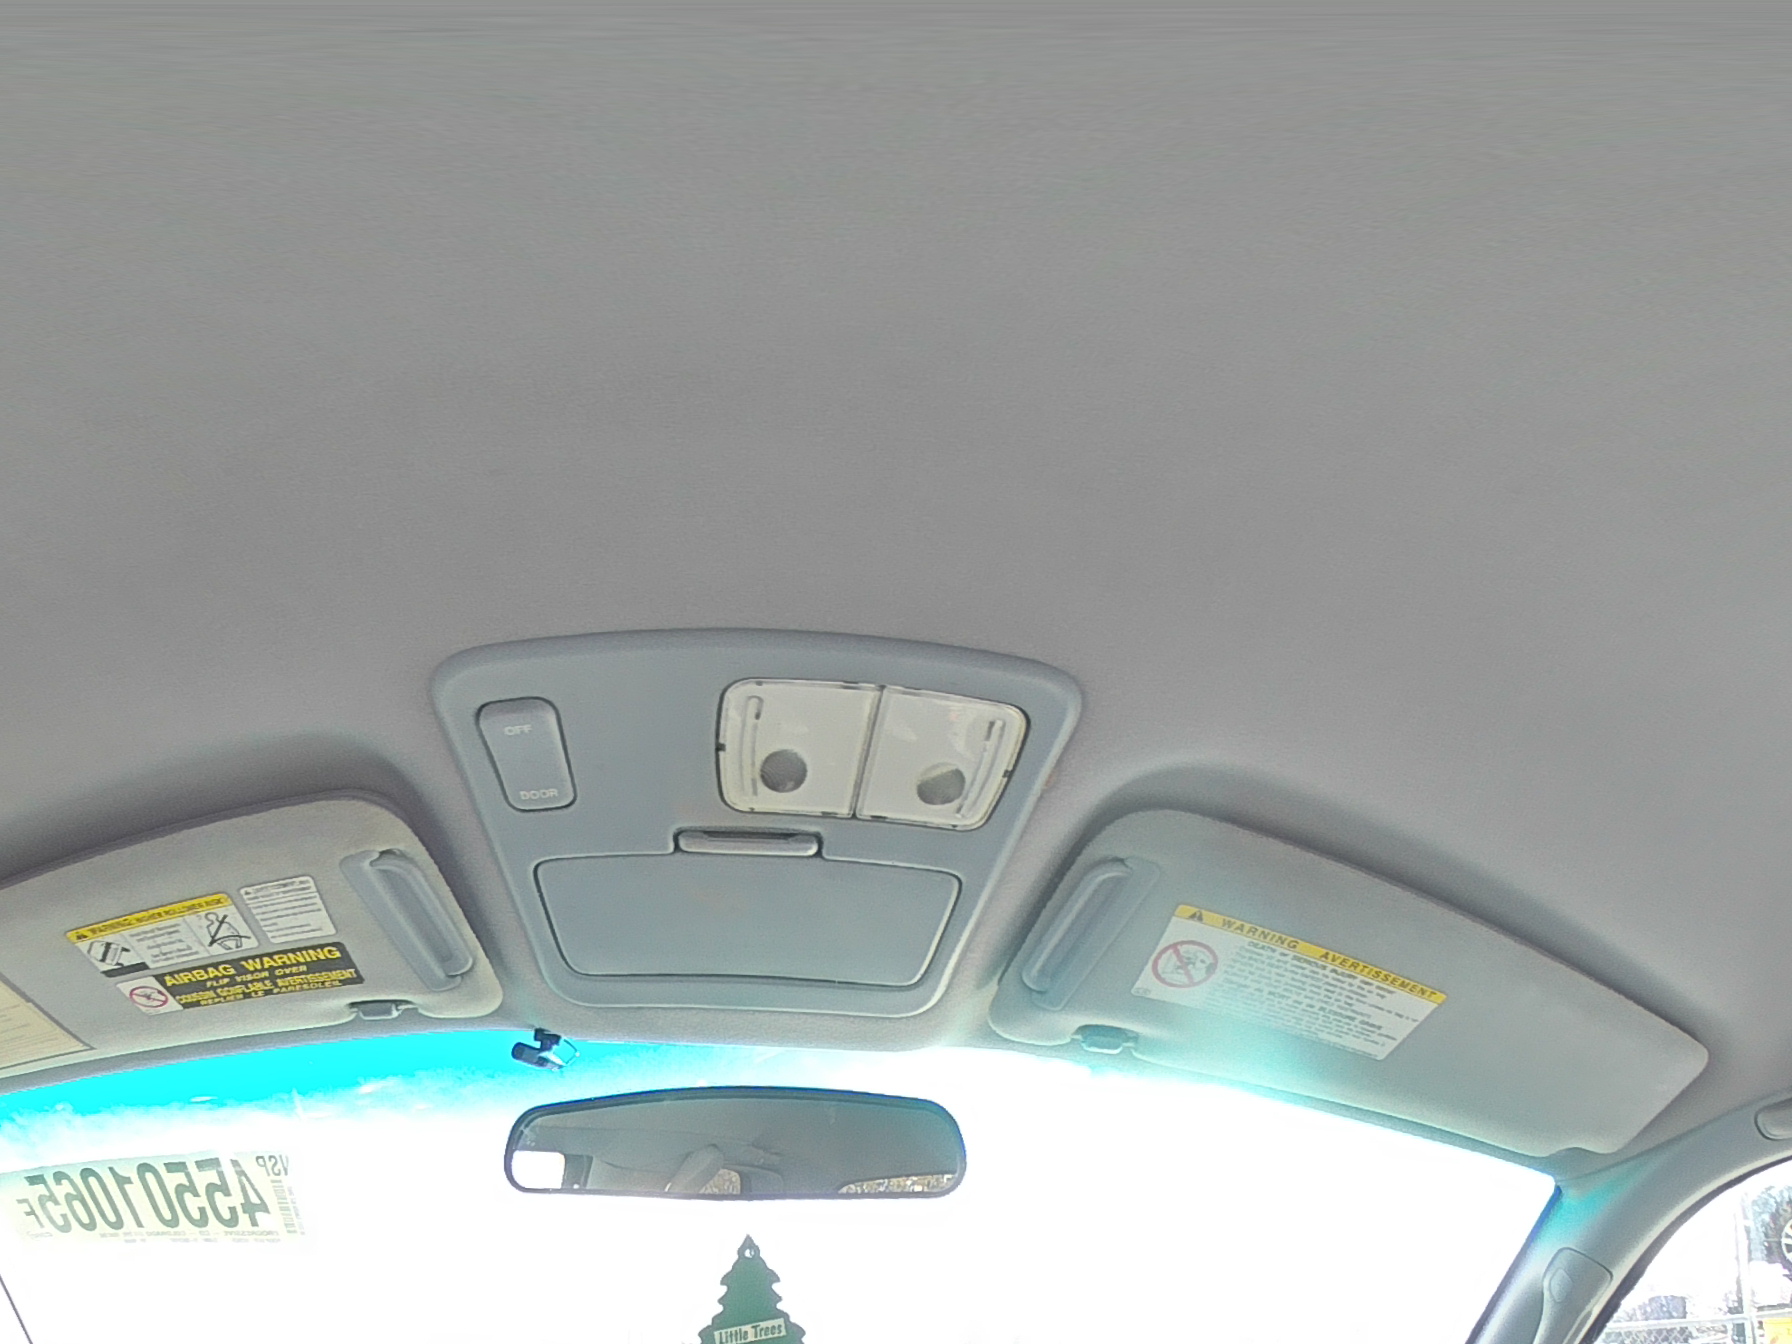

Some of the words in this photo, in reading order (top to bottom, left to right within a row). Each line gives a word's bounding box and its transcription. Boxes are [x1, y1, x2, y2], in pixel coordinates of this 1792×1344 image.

[504, 724, 533, 735] OFF
[519, 788, 558, 800] DOOR
[164, 964, 237, 987] AIRBAG
[240, 946, 342, 972] WARNING
[1220, 917, 1299, 950] WARNING
[1319, 950, 1438, 1000] AVERTISSEMENT
[235, 970, 270, 983] VISOR
[274, 964, 308, 977] OVER
[751, 1322, 783, 1340] Trees
